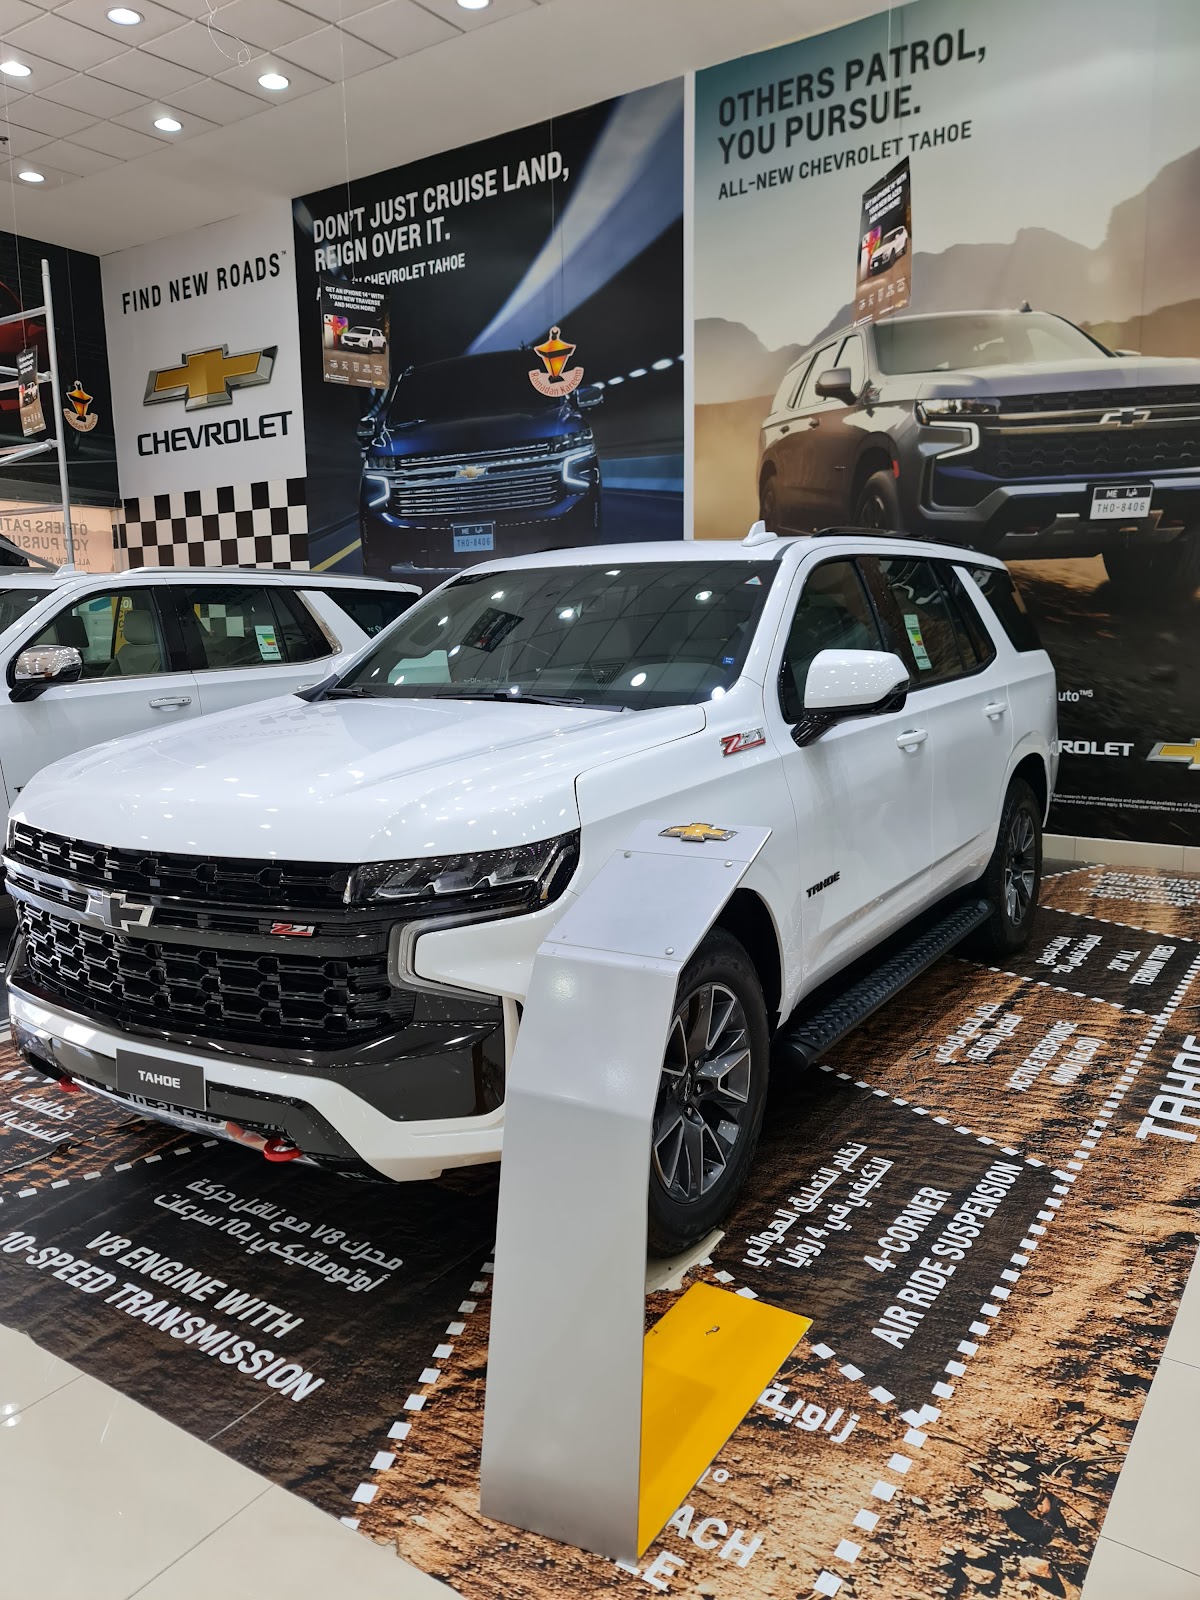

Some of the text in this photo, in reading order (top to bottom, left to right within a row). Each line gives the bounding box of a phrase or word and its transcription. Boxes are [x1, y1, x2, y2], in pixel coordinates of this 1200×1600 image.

[718, 28, 987, 128] OTHERS PATROL,
[717, 84, 921, 165] YOU PURSUE.
[718, 120, 973, 200] ALL-NEW CHEVROLET TAHOE
[312, 151, 570, 245] DON'T JUST CRUISE LAND,
[314, 216, 451, 272] REIGN OVER IT.
[428, 252, 466, 275] TAHOE
[122, 284, 162, 314] FIND
[169, 274, 209, 303] NEW
[531, 369, 582, 395] Ramadan Kareem
[137, 411, 293, 457] CHEVROLET
[719, 727, 766, 757] Z71
[1058, 740, 1134, 756] ROLET
[270, 923, 315, 936] Z71
[1005, 1020, 1079, 1092] ACTIVE RESPONSE
[1049, 1036, 1107, 1085] 4WD (ELSD)
[138, 1070, 181, 1089] TAHOE
[833, 1141, 868, 1173] نظام
[153, 1193, 225, 1227] سرعات
[788, 1167, 842, 1213] التعليق
[186, 1178, 404, 1270] محرك V8 مع ناقل حركة
[805, 1226, 830, 1239] 4
[823, 1203, 853, 1232] في
[863, 1187, 953, 1273] 4-CORNER
[871, 1160, 1024, 1350] AIR RIDE SUSPENSION
[85, 1231, 304, 1339] V8 ENGINE WITH
[0, 1231, 325, 1402] 10-SPEED TRANSMISSION
